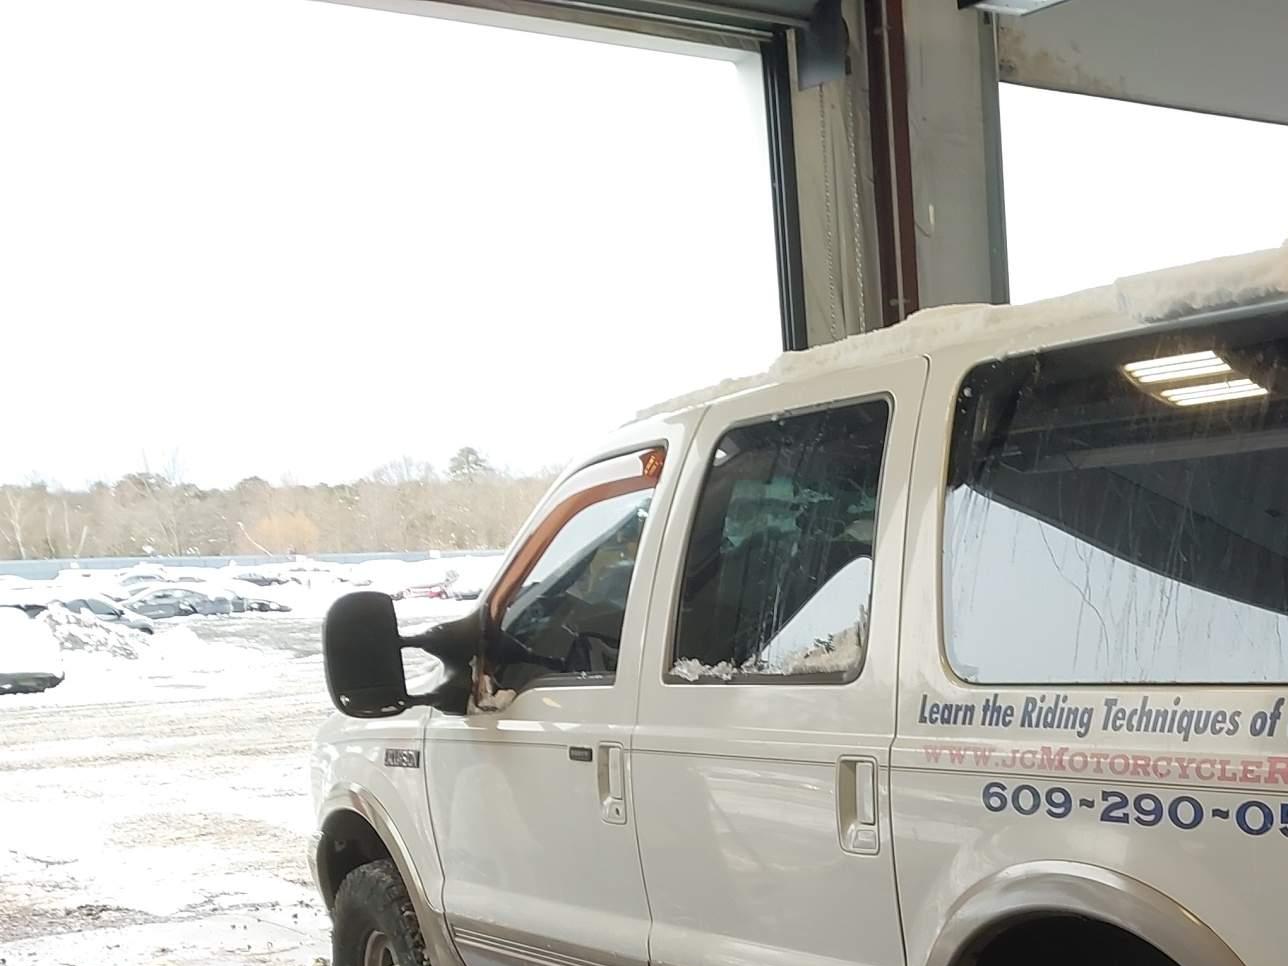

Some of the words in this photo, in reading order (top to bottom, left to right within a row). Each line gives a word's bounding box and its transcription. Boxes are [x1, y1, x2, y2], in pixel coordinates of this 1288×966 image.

[918, 694, 976, 727] Learn
[980, 694, 1015, 728] the
[1020, 695, 1094, 738] Riding
[1100, 697, 1240, 742] Techniques
[1249, 698, 1285, 737] of
